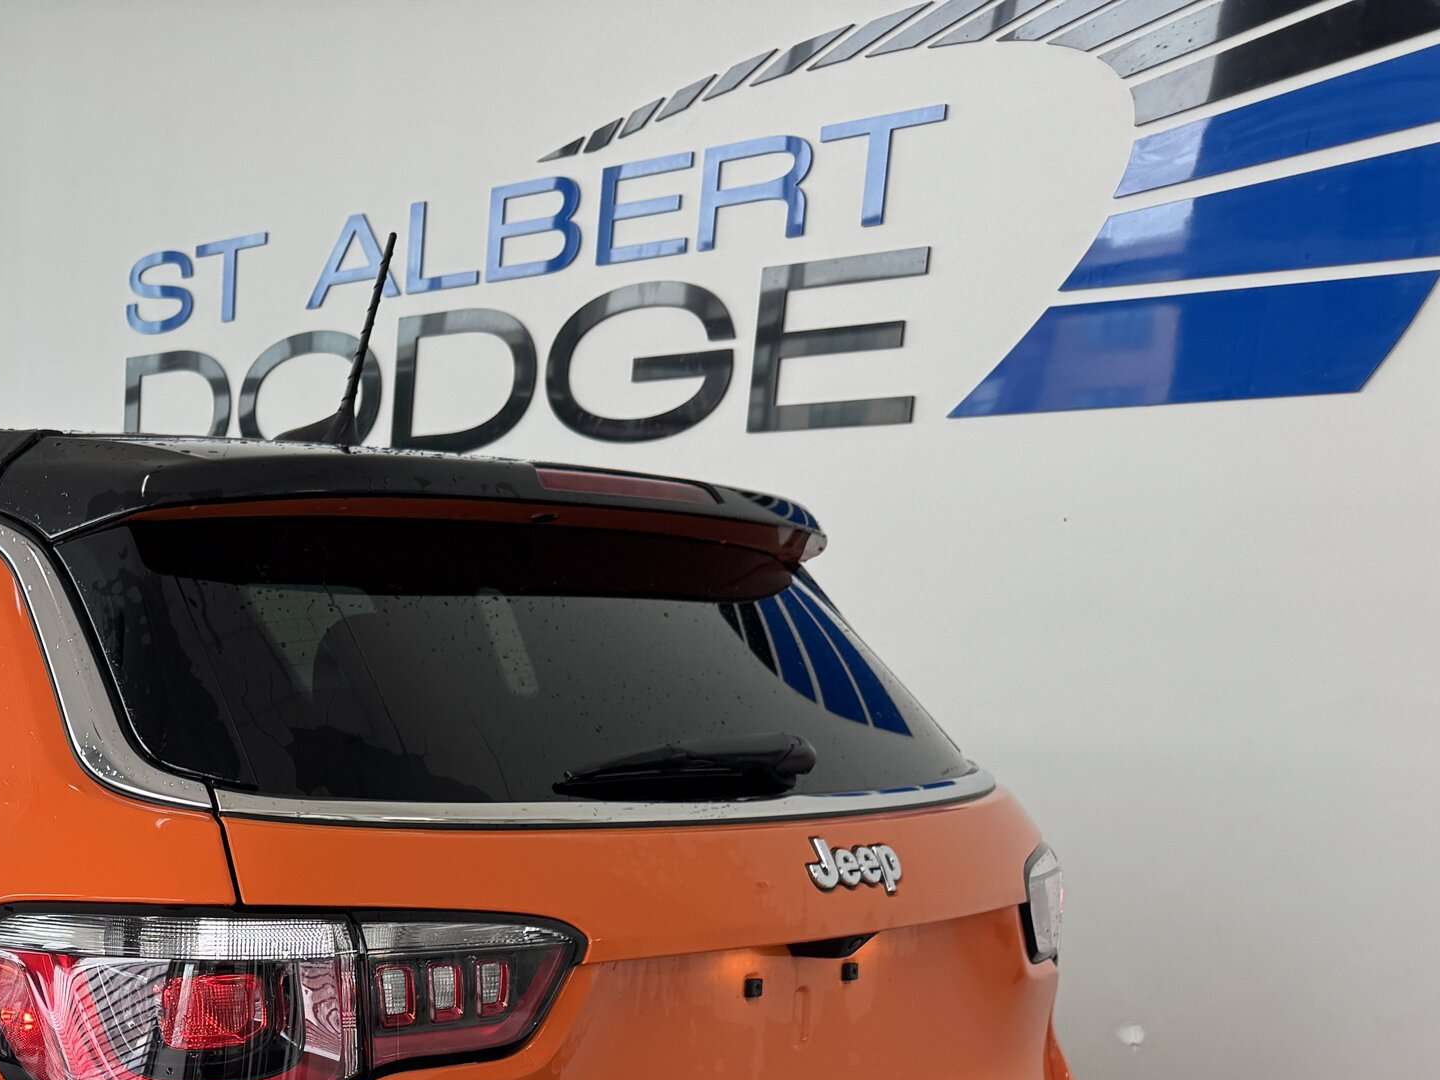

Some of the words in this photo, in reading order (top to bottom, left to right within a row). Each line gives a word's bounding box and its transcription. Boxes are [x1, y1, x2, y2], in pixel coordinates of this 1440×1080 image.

[125, 231, 269, 336] ST
[305, 103, 949, 311] ALBERT
[123, 246, 932, 453] DODGE
[805, 836, 902, 896] Jeep
